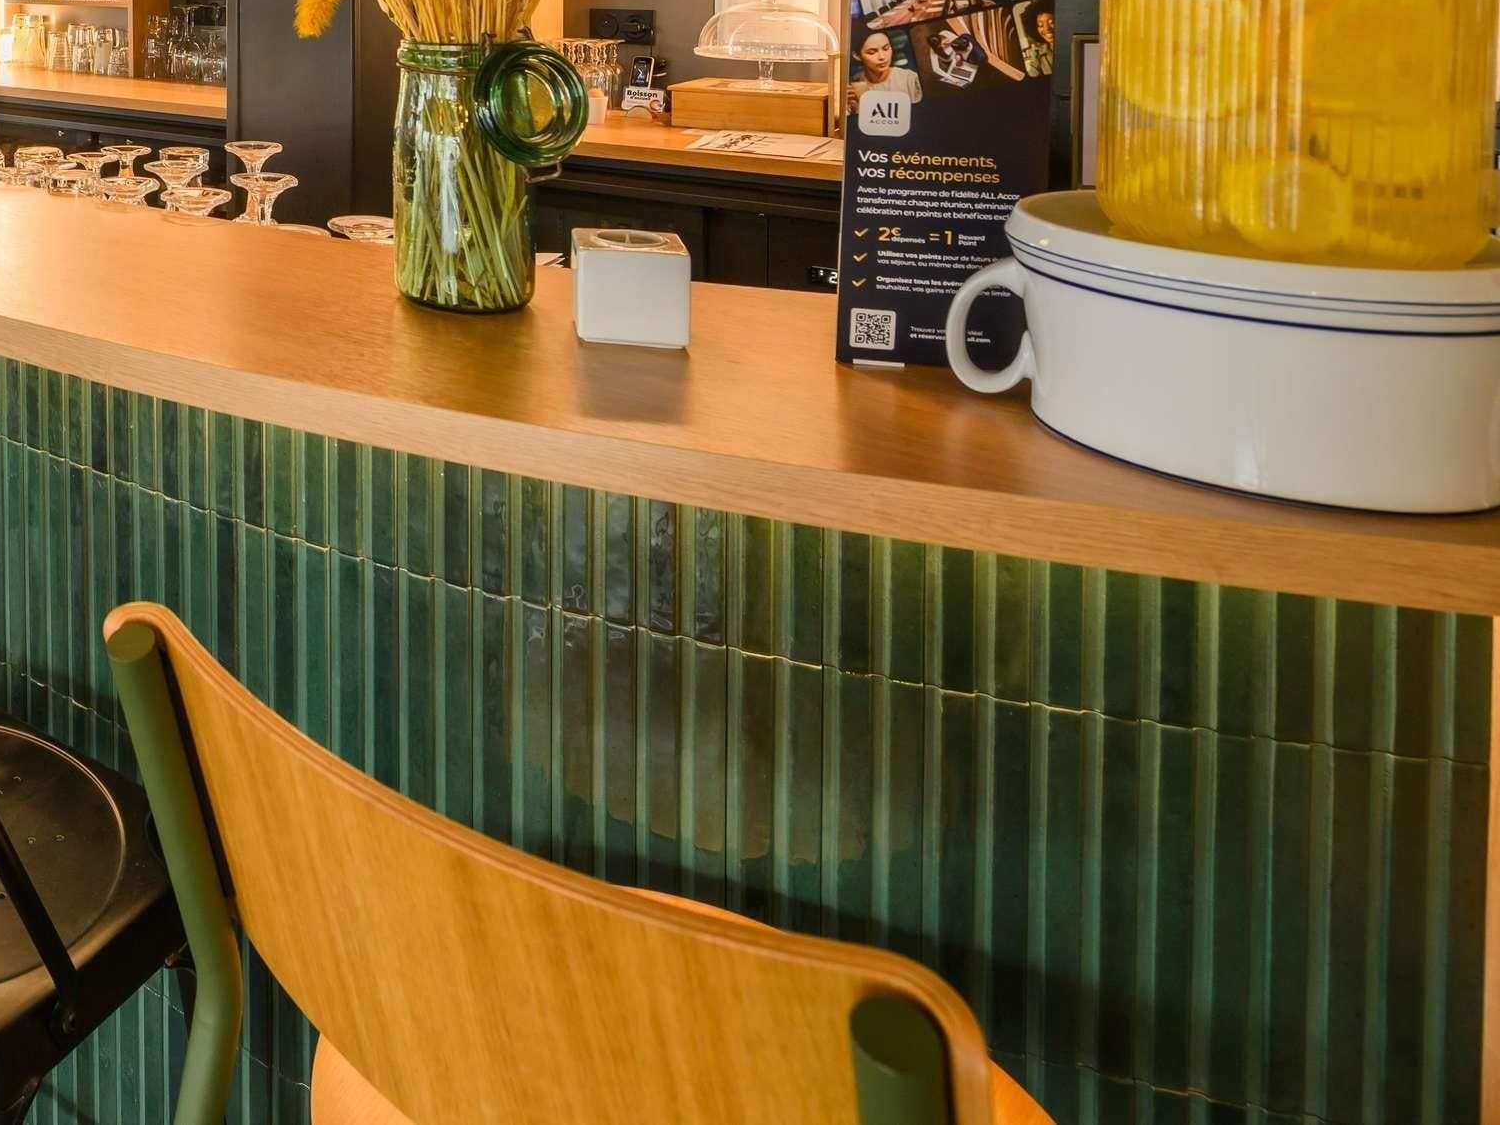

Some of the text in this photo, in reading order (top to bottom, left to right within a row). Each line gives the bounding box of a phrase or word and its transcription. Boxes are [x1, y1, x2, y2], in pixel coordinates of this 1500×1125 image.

[871, 102, 900, 119] All
[858, 149, 998, 170] Vos événements,
[857, 166, 1001, 185] vos récompenses
[857, 185, 878, 194] Avec
[878, 186, 887, 195] le
[887, 188, 938, 198] programme
[938, 189, 951, 198] de
[857, 196, 907, 206] transformez
[907, 198, 940, 209] chaque
[940, 199, 974, 210] réunion,
[856, 205, 903, 216] célébration
[903, 209, 915, 217] en
[915, 209, 942, 219] points
[942, 211, 952, 219] et
[943, 230, 953, 245] 1
